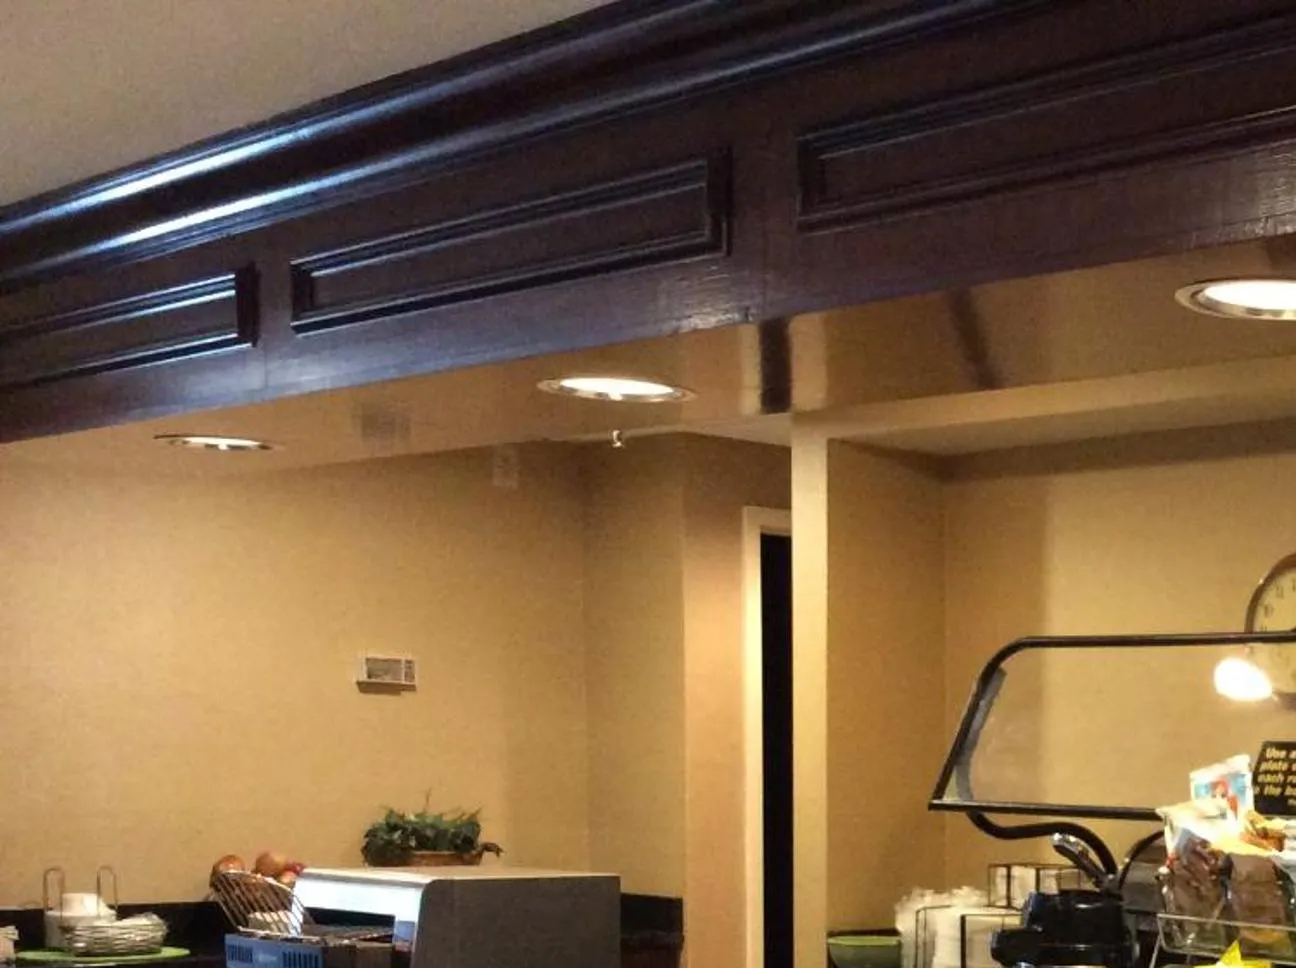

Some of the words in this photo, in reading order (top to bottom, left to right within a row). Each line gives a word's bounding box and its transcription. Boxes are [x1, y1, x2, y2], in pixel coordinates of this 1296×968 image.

[1265, 747, 1287, 759] Use
[1259, 761, 1288, 773] plate
[1257, 772, 1284, 784] each
[1263, 785, 1282, 796] the
